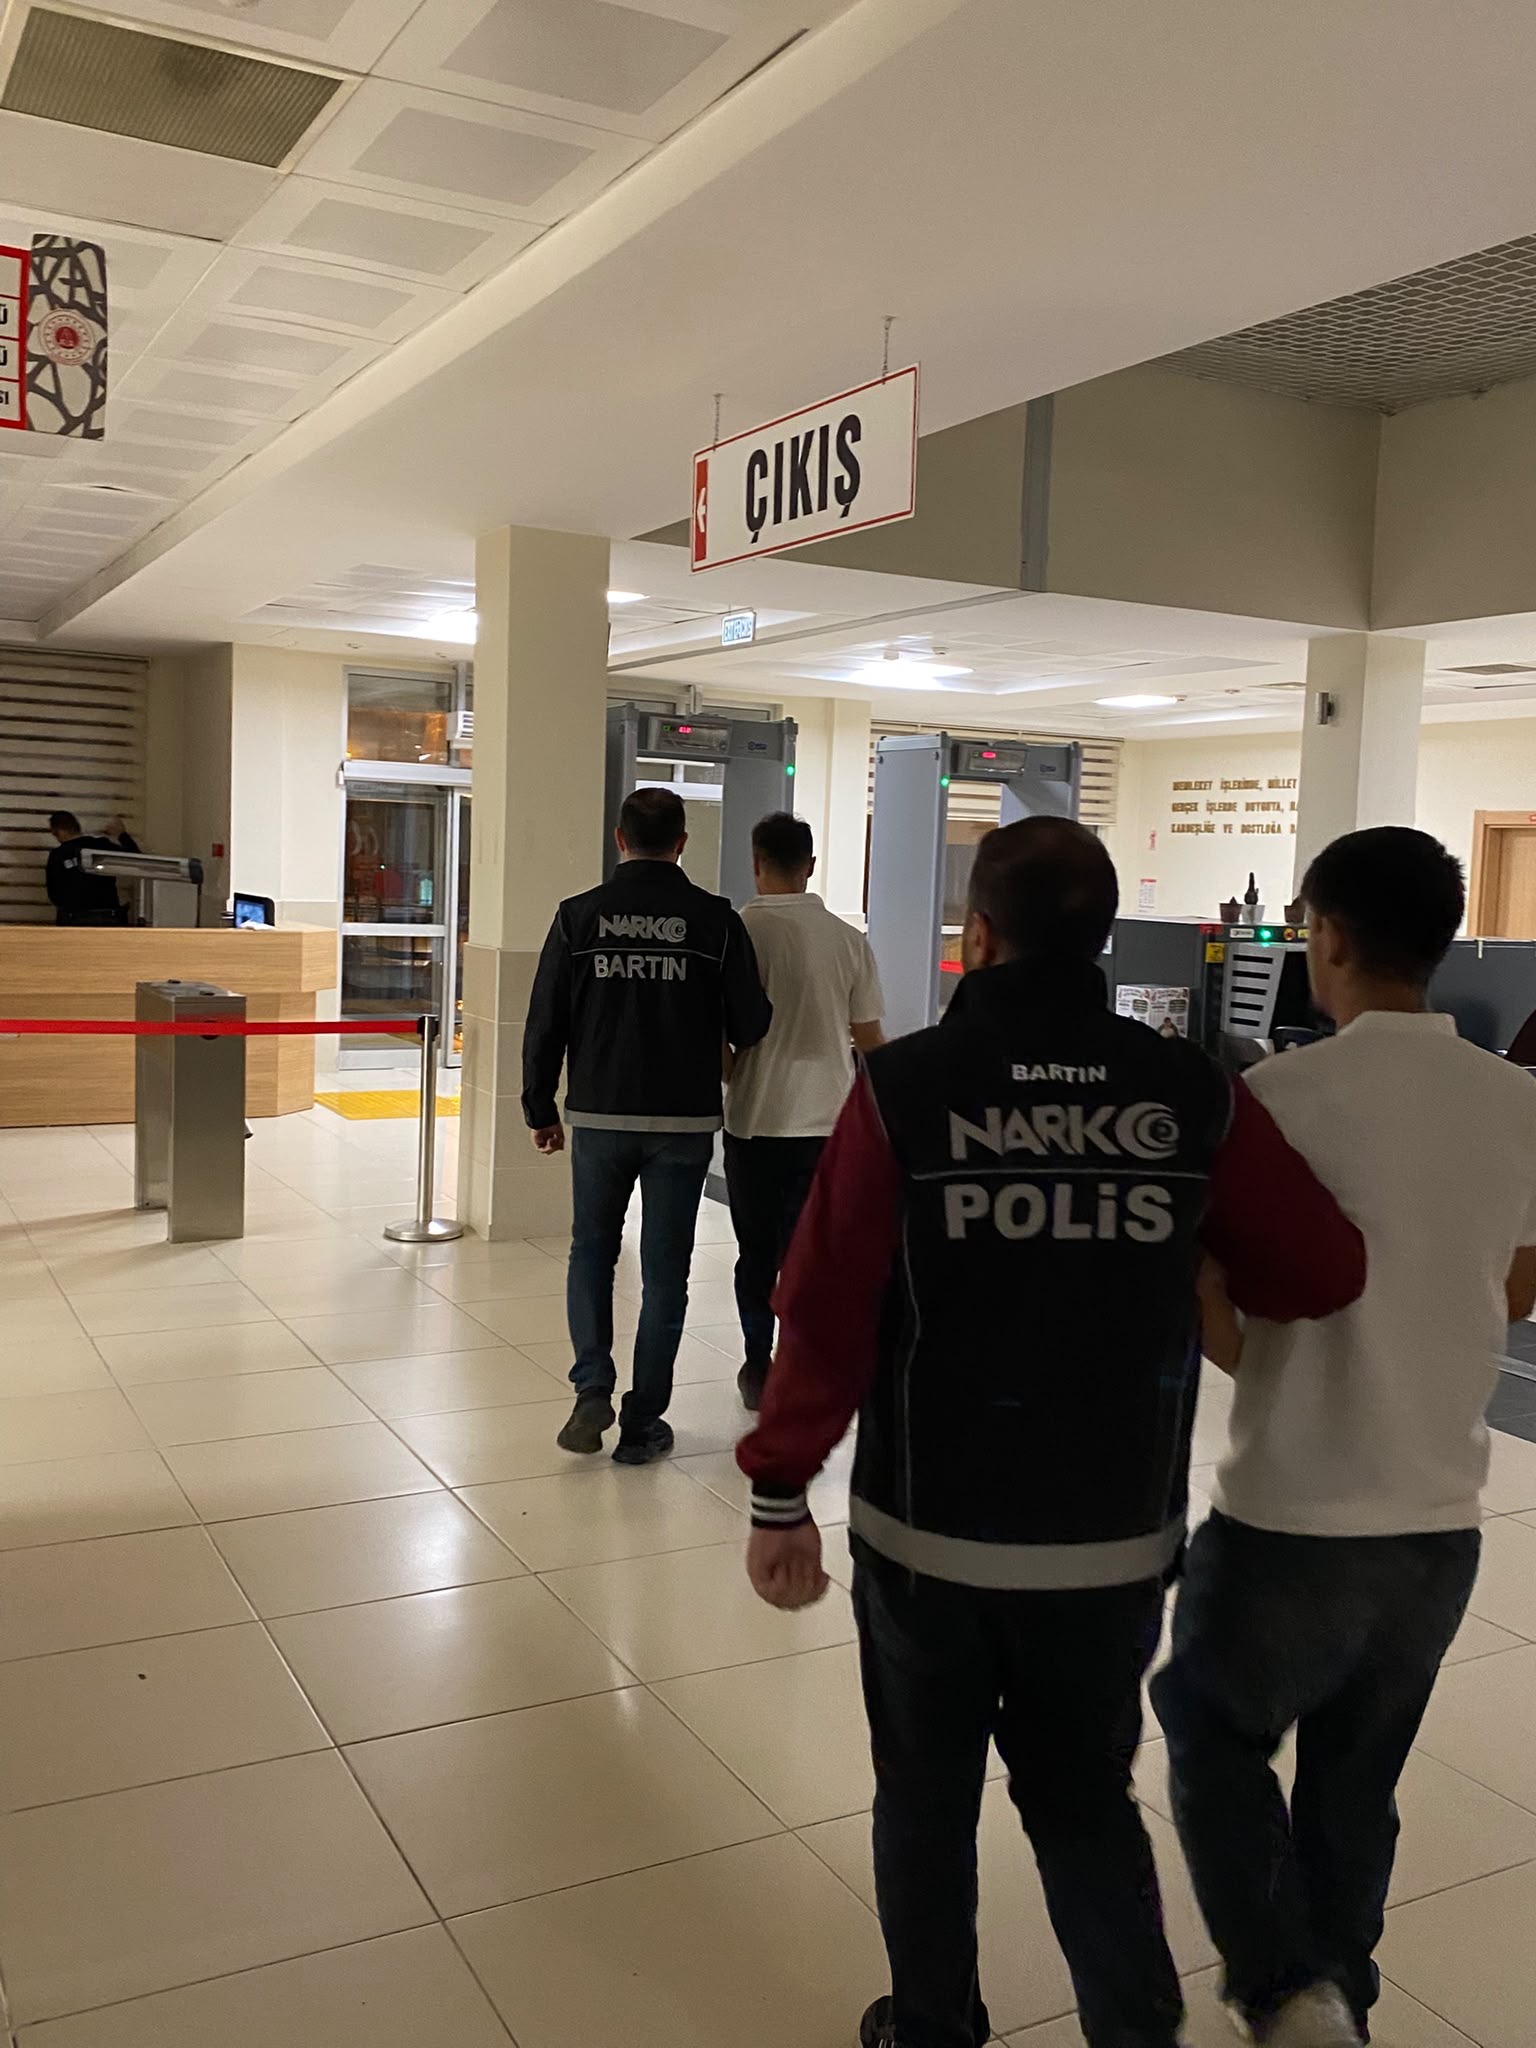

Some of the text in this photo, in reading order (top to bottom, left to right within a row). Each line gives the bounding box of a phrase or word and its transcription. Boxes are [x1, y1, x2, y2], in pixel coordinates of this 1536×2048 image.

[746, 414, 861, 543] ÇIKIŞ
[1223, 823, 1233, 834] VE
[598, 914, 687, 943] NARKO
[594, 954, 687, 981] BARTIN
[1011, 1063, 1107, 1083] BARTIN
[949, 1101, 1180, 1160] NARKO
